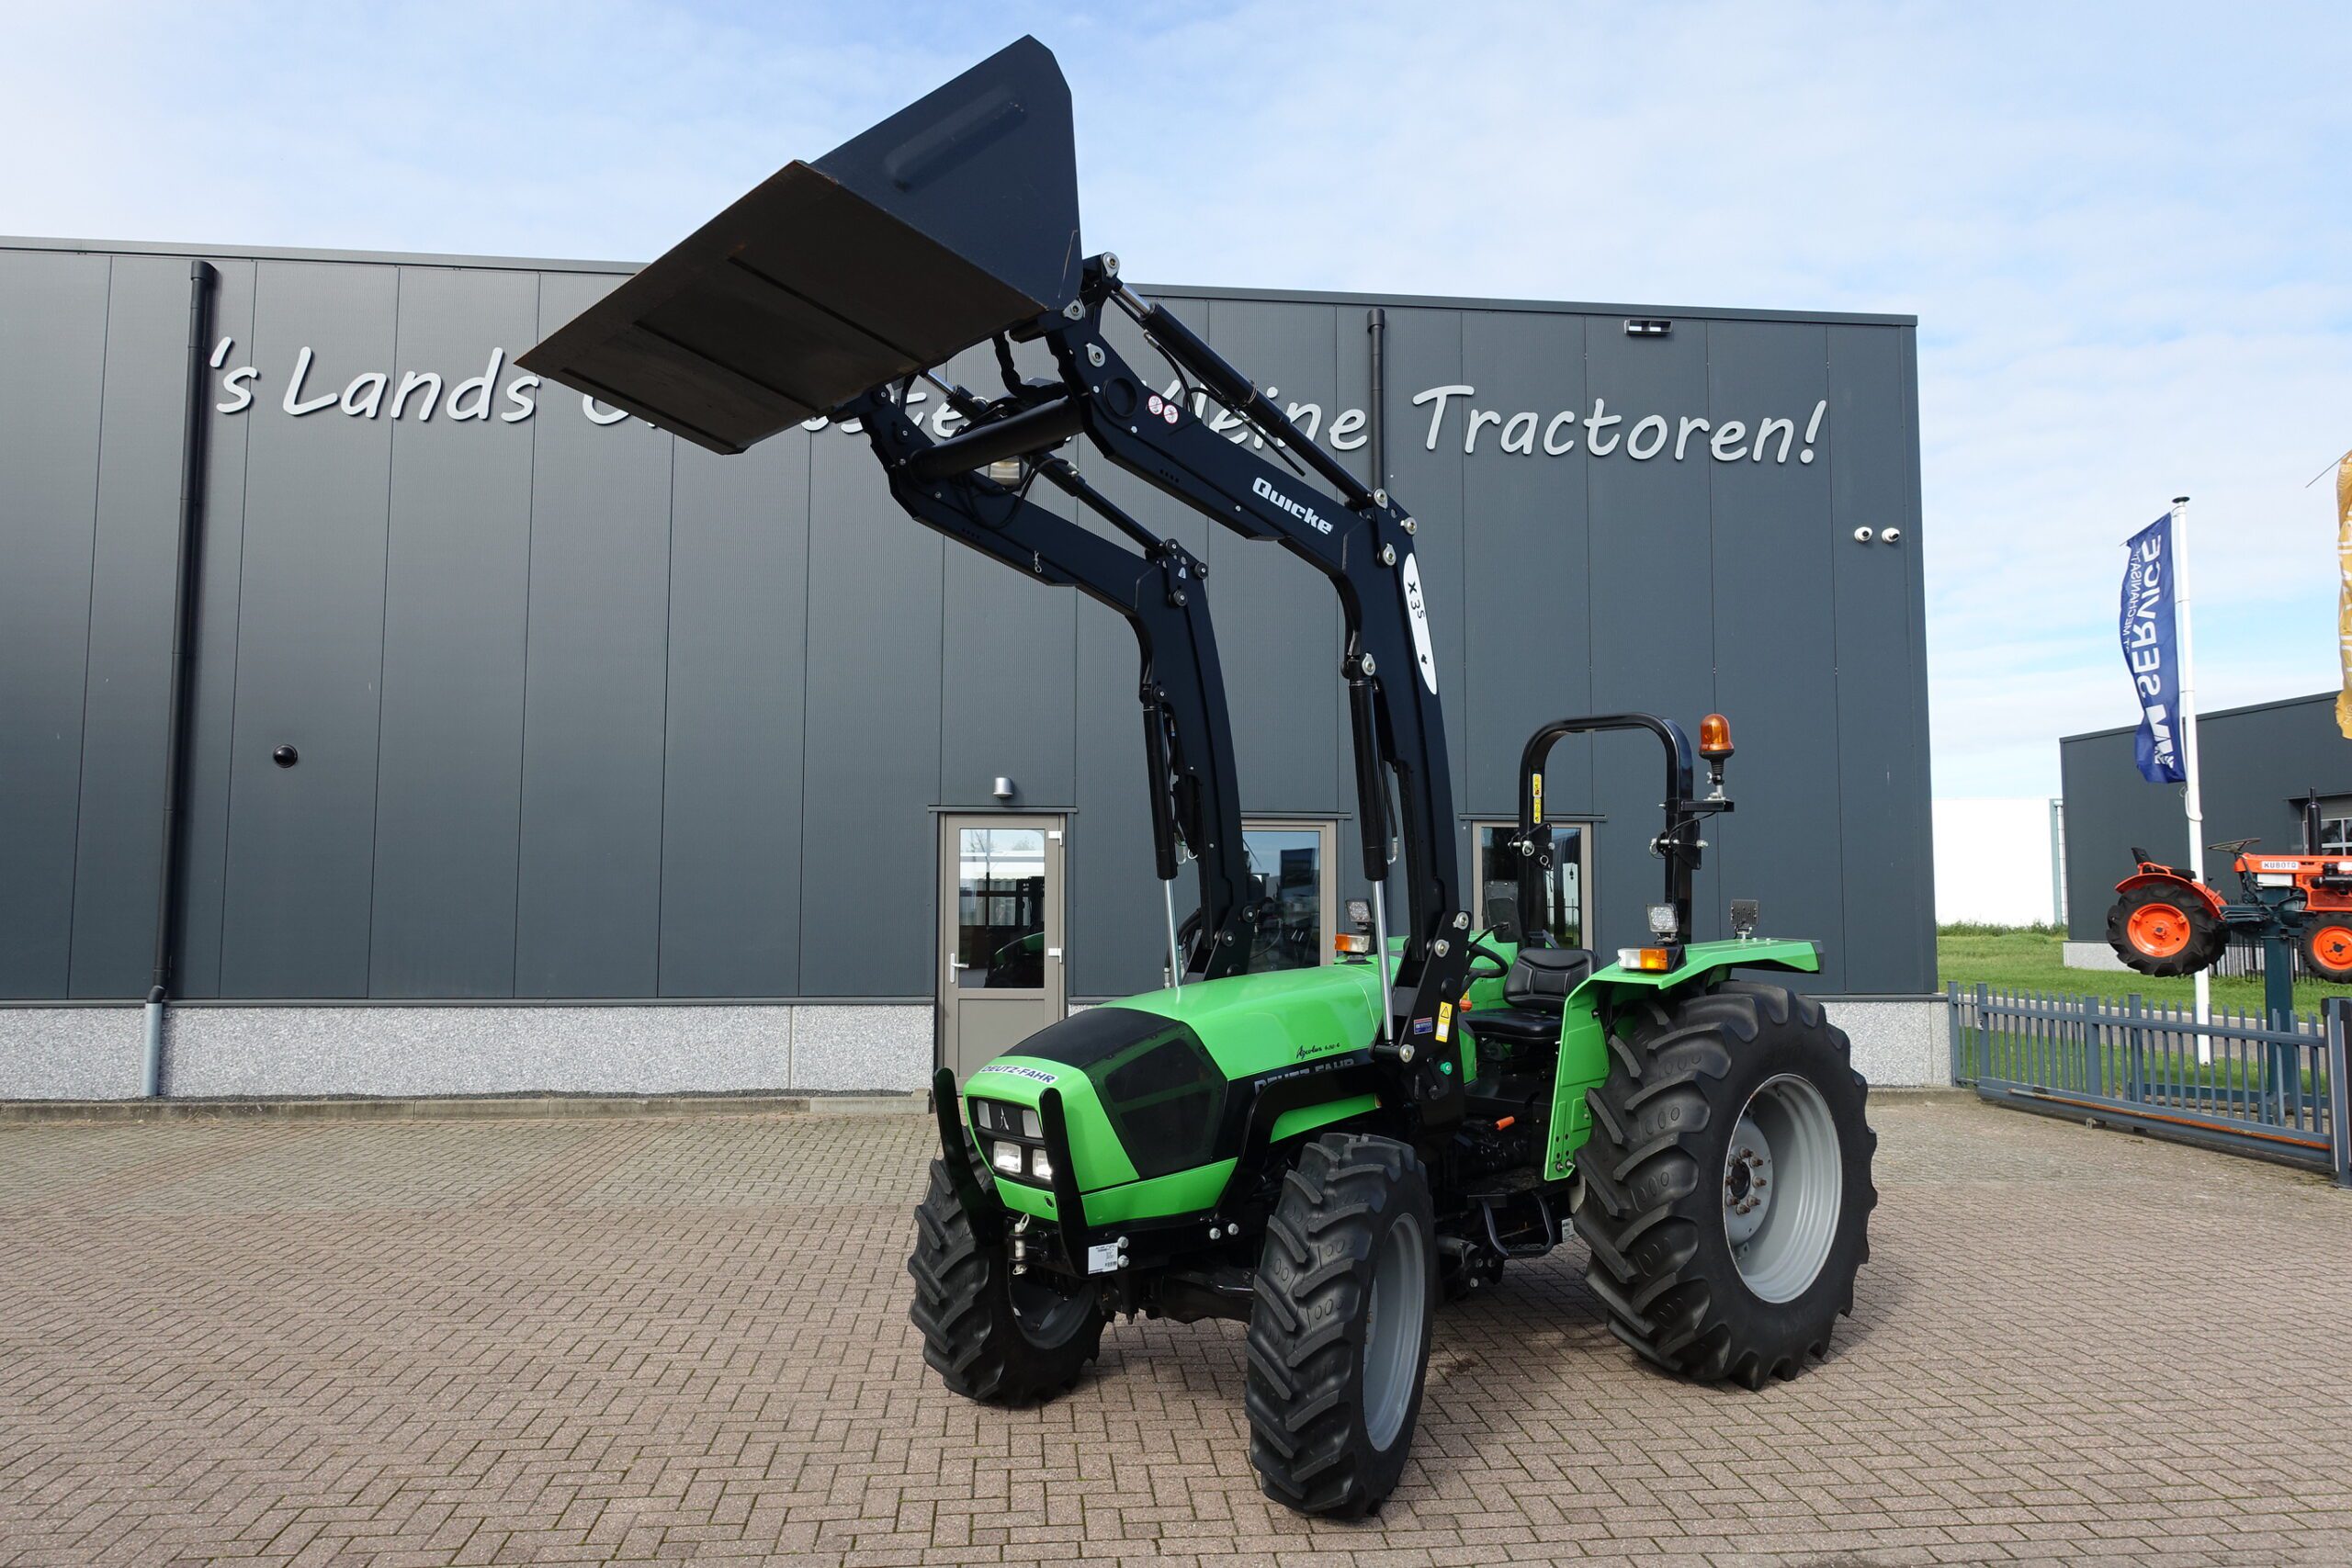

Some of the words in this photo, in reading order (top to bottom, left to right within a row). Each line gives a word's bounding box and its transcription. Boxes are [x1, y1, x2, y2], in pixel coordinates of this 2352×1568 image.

[209, 336, 258, 414] 's
[281, 345, 540, 423] Lands
[1412, 384, 1826, 464] Tractoren!
[1252, 477, 1334, 535] Quicke
[981, 1066, 1056, 1083] DEUTZ-FAHR
